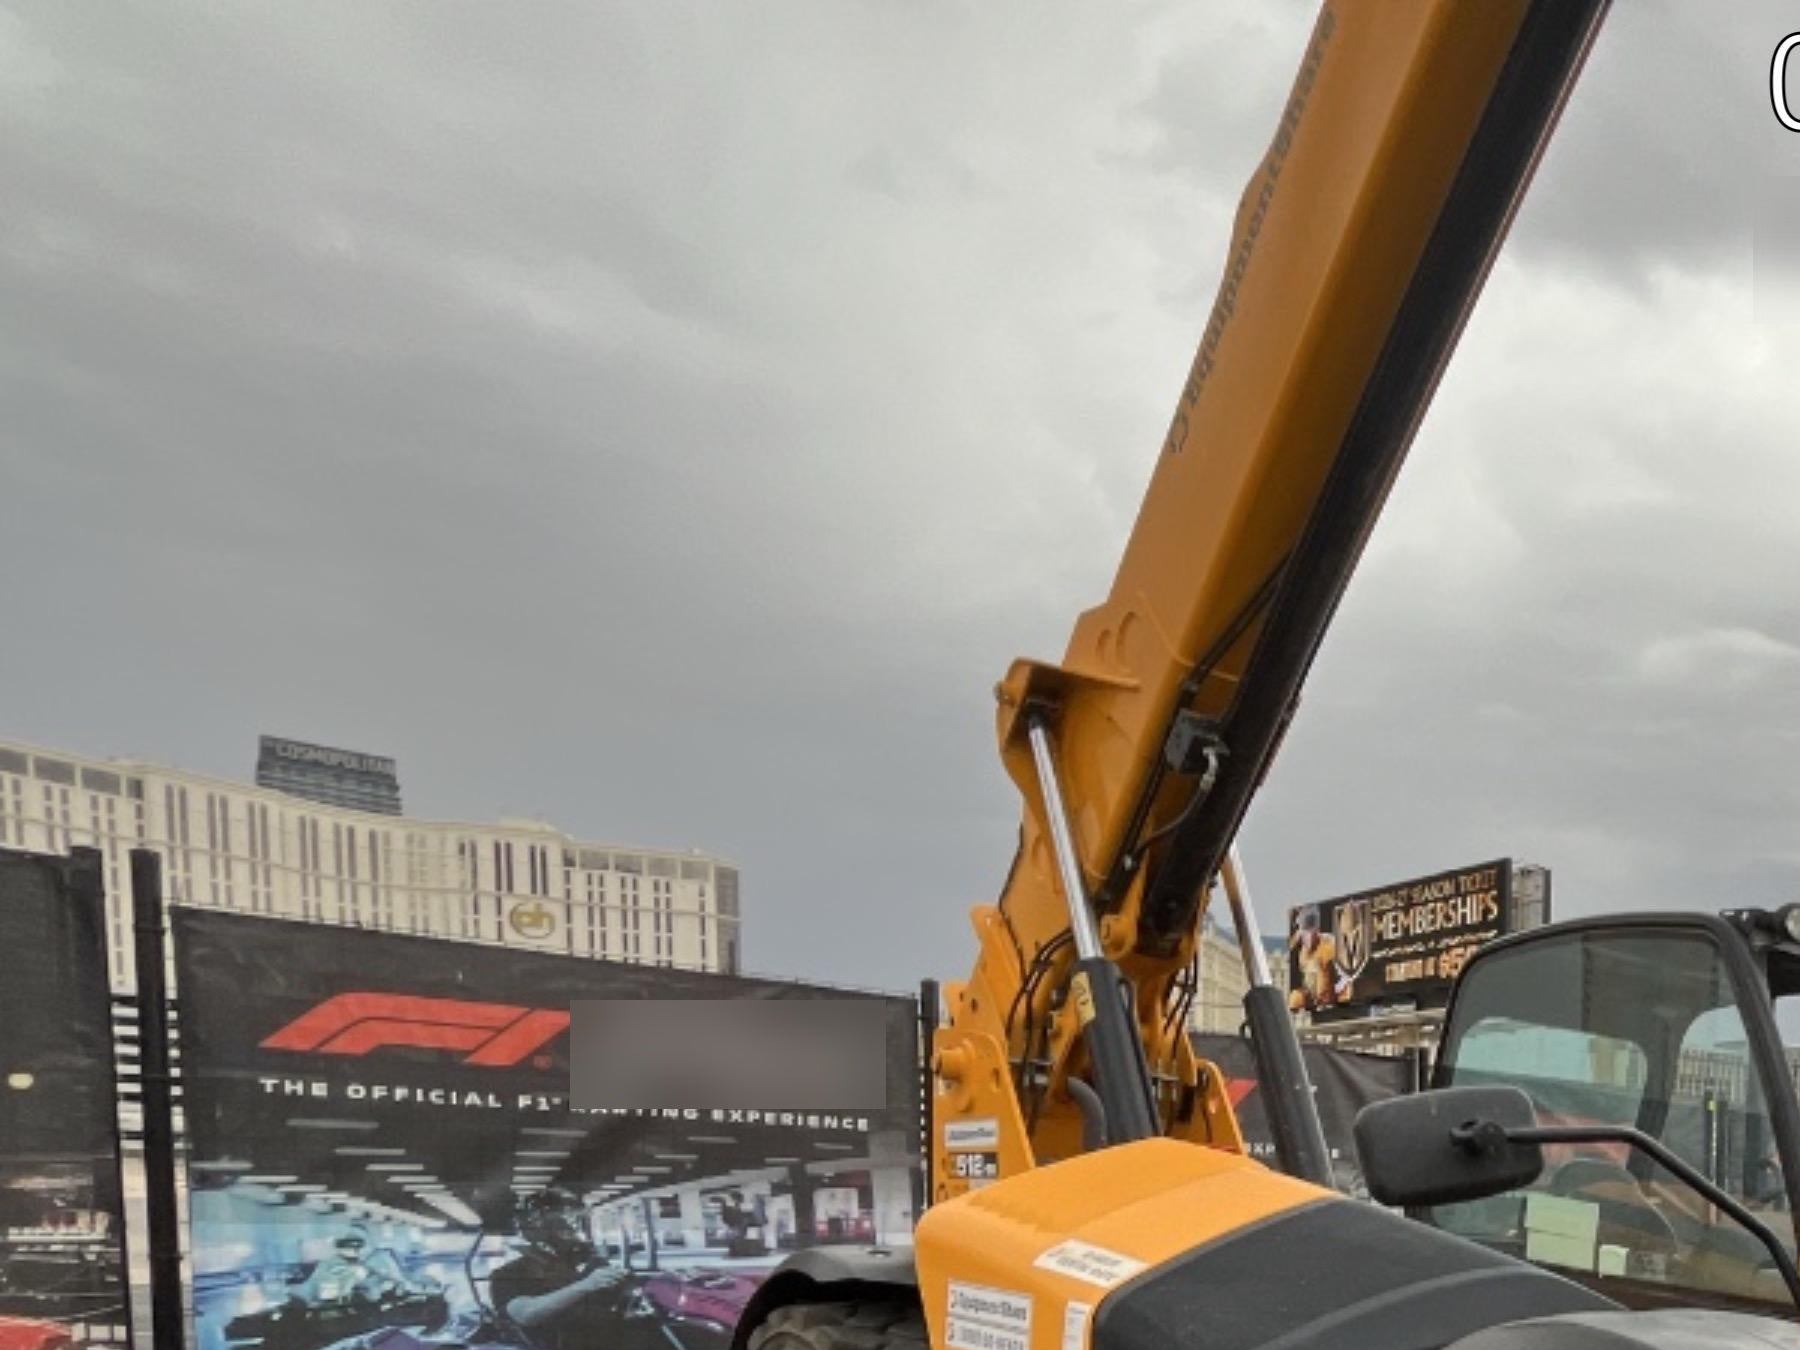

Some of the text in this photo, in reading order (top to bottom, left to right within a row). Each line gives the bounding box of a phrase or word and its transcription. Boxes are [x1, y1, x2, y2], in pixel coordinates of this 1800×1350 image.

[1370, 890, 1498, 943] MEMBERSHIPS
[258, 1076, 329, 1098] THE
[346, 1082, 503, 1109] OFFICIAL
[711, 1108, 869, 1132] EXPERIENCE
